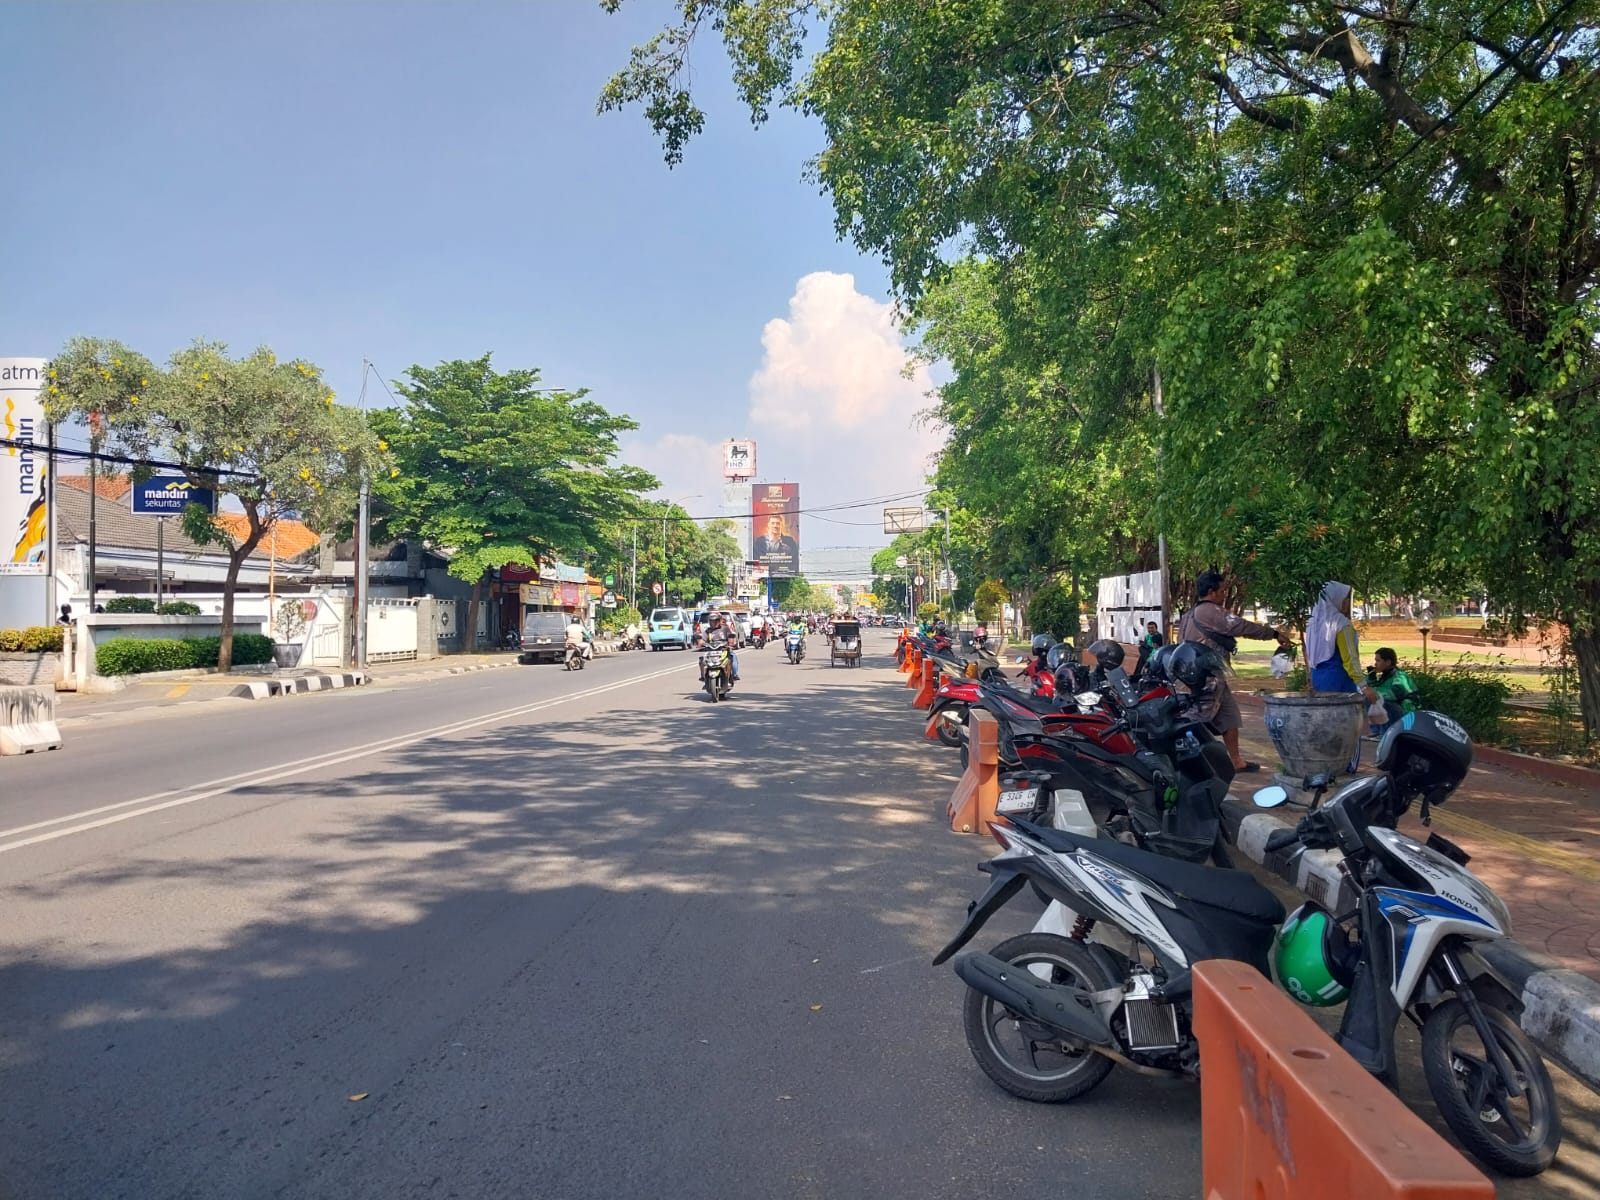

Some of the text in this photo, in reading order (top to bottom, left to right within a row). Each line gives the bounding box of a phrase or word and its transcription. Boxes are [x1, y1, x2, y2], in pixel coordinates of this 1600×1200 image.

[2, 365, 38, 380] atm
[15, 418, 34, 494] mandiri
[144, 487, 189, 499] mandiri
[144, 499, 181, 508] sekuritas
[1440, 889, 1480, 914] HONDA
